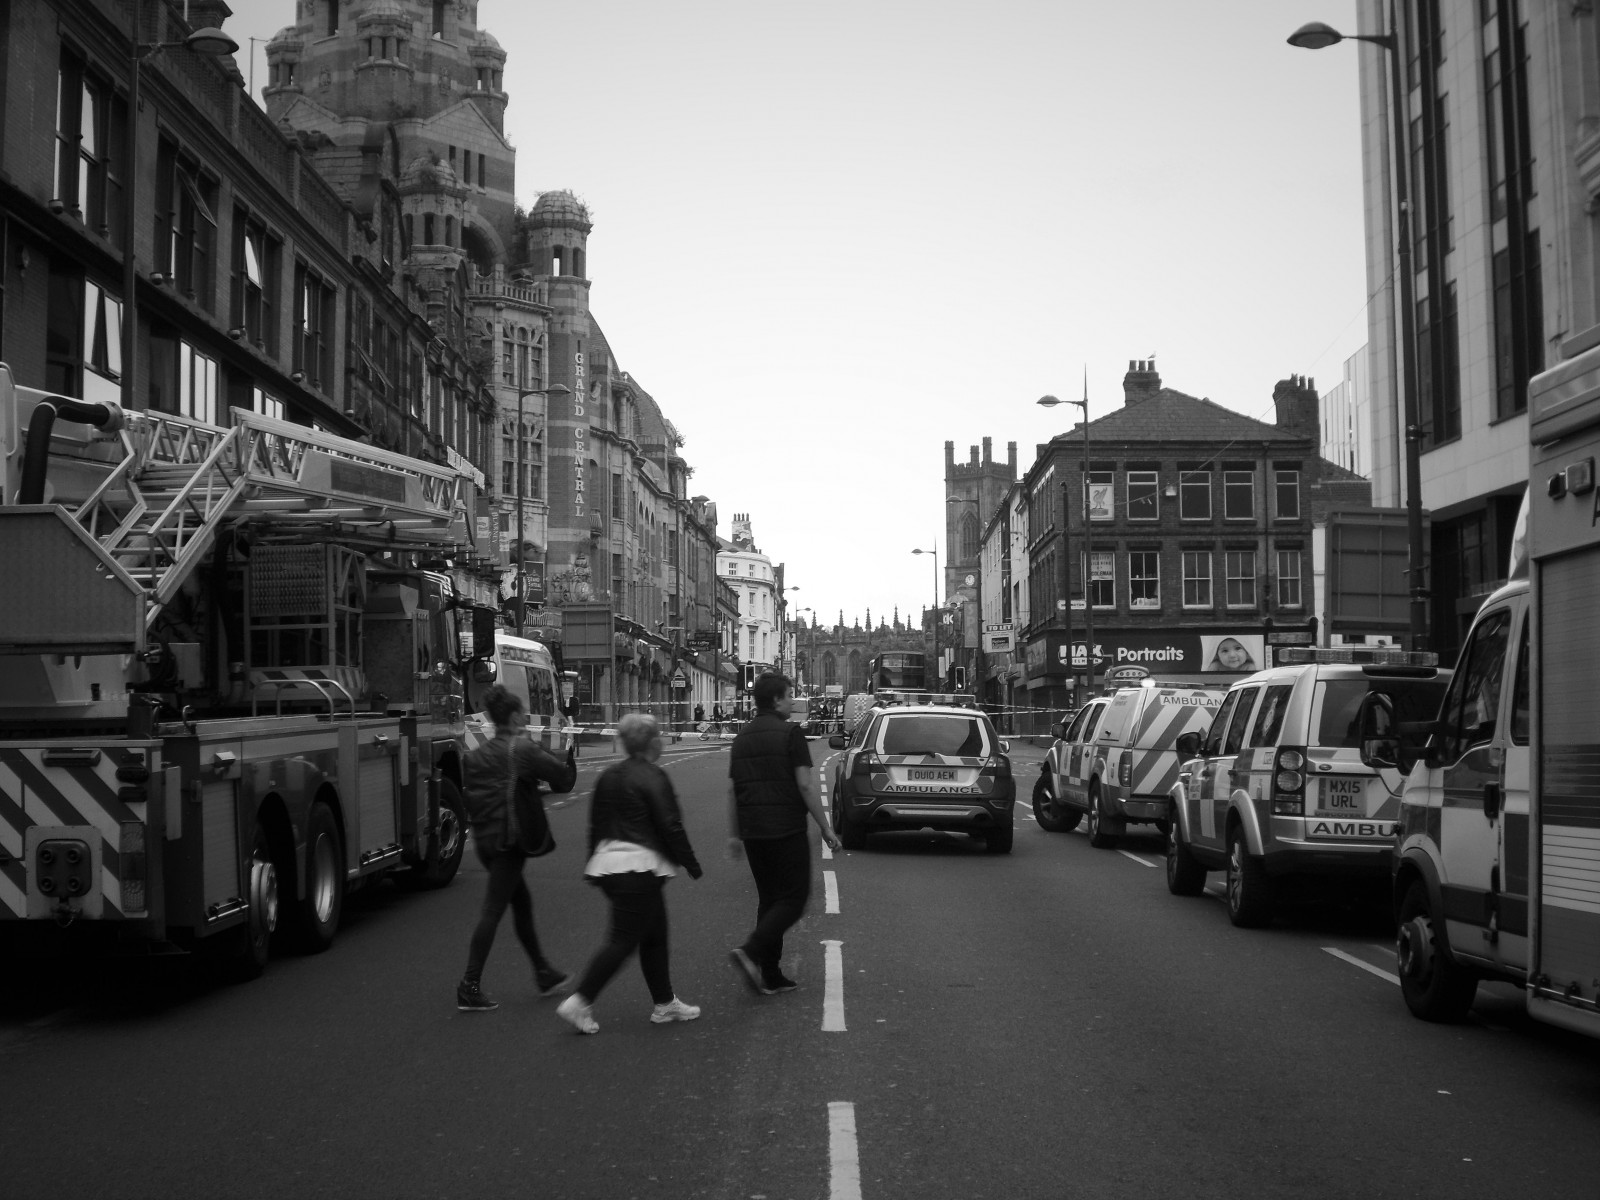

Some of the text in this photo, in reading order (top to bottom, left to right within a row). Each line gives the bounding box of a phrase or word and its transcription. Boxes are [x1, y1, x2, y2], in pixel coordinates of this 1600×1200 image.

[574, 353, 585, 517] GRAND CENTRAL
[1117, 646, 1184, 661] Portraits
[1163, 696, 1222, 706] AMBULAN
[885, 785, 979, 793] AMBULANCE
[1330, 781, 1360, 793] MX15
[1331, 796, 1358, 808] URL
[1312, 822, 1395, 837] AMBU
